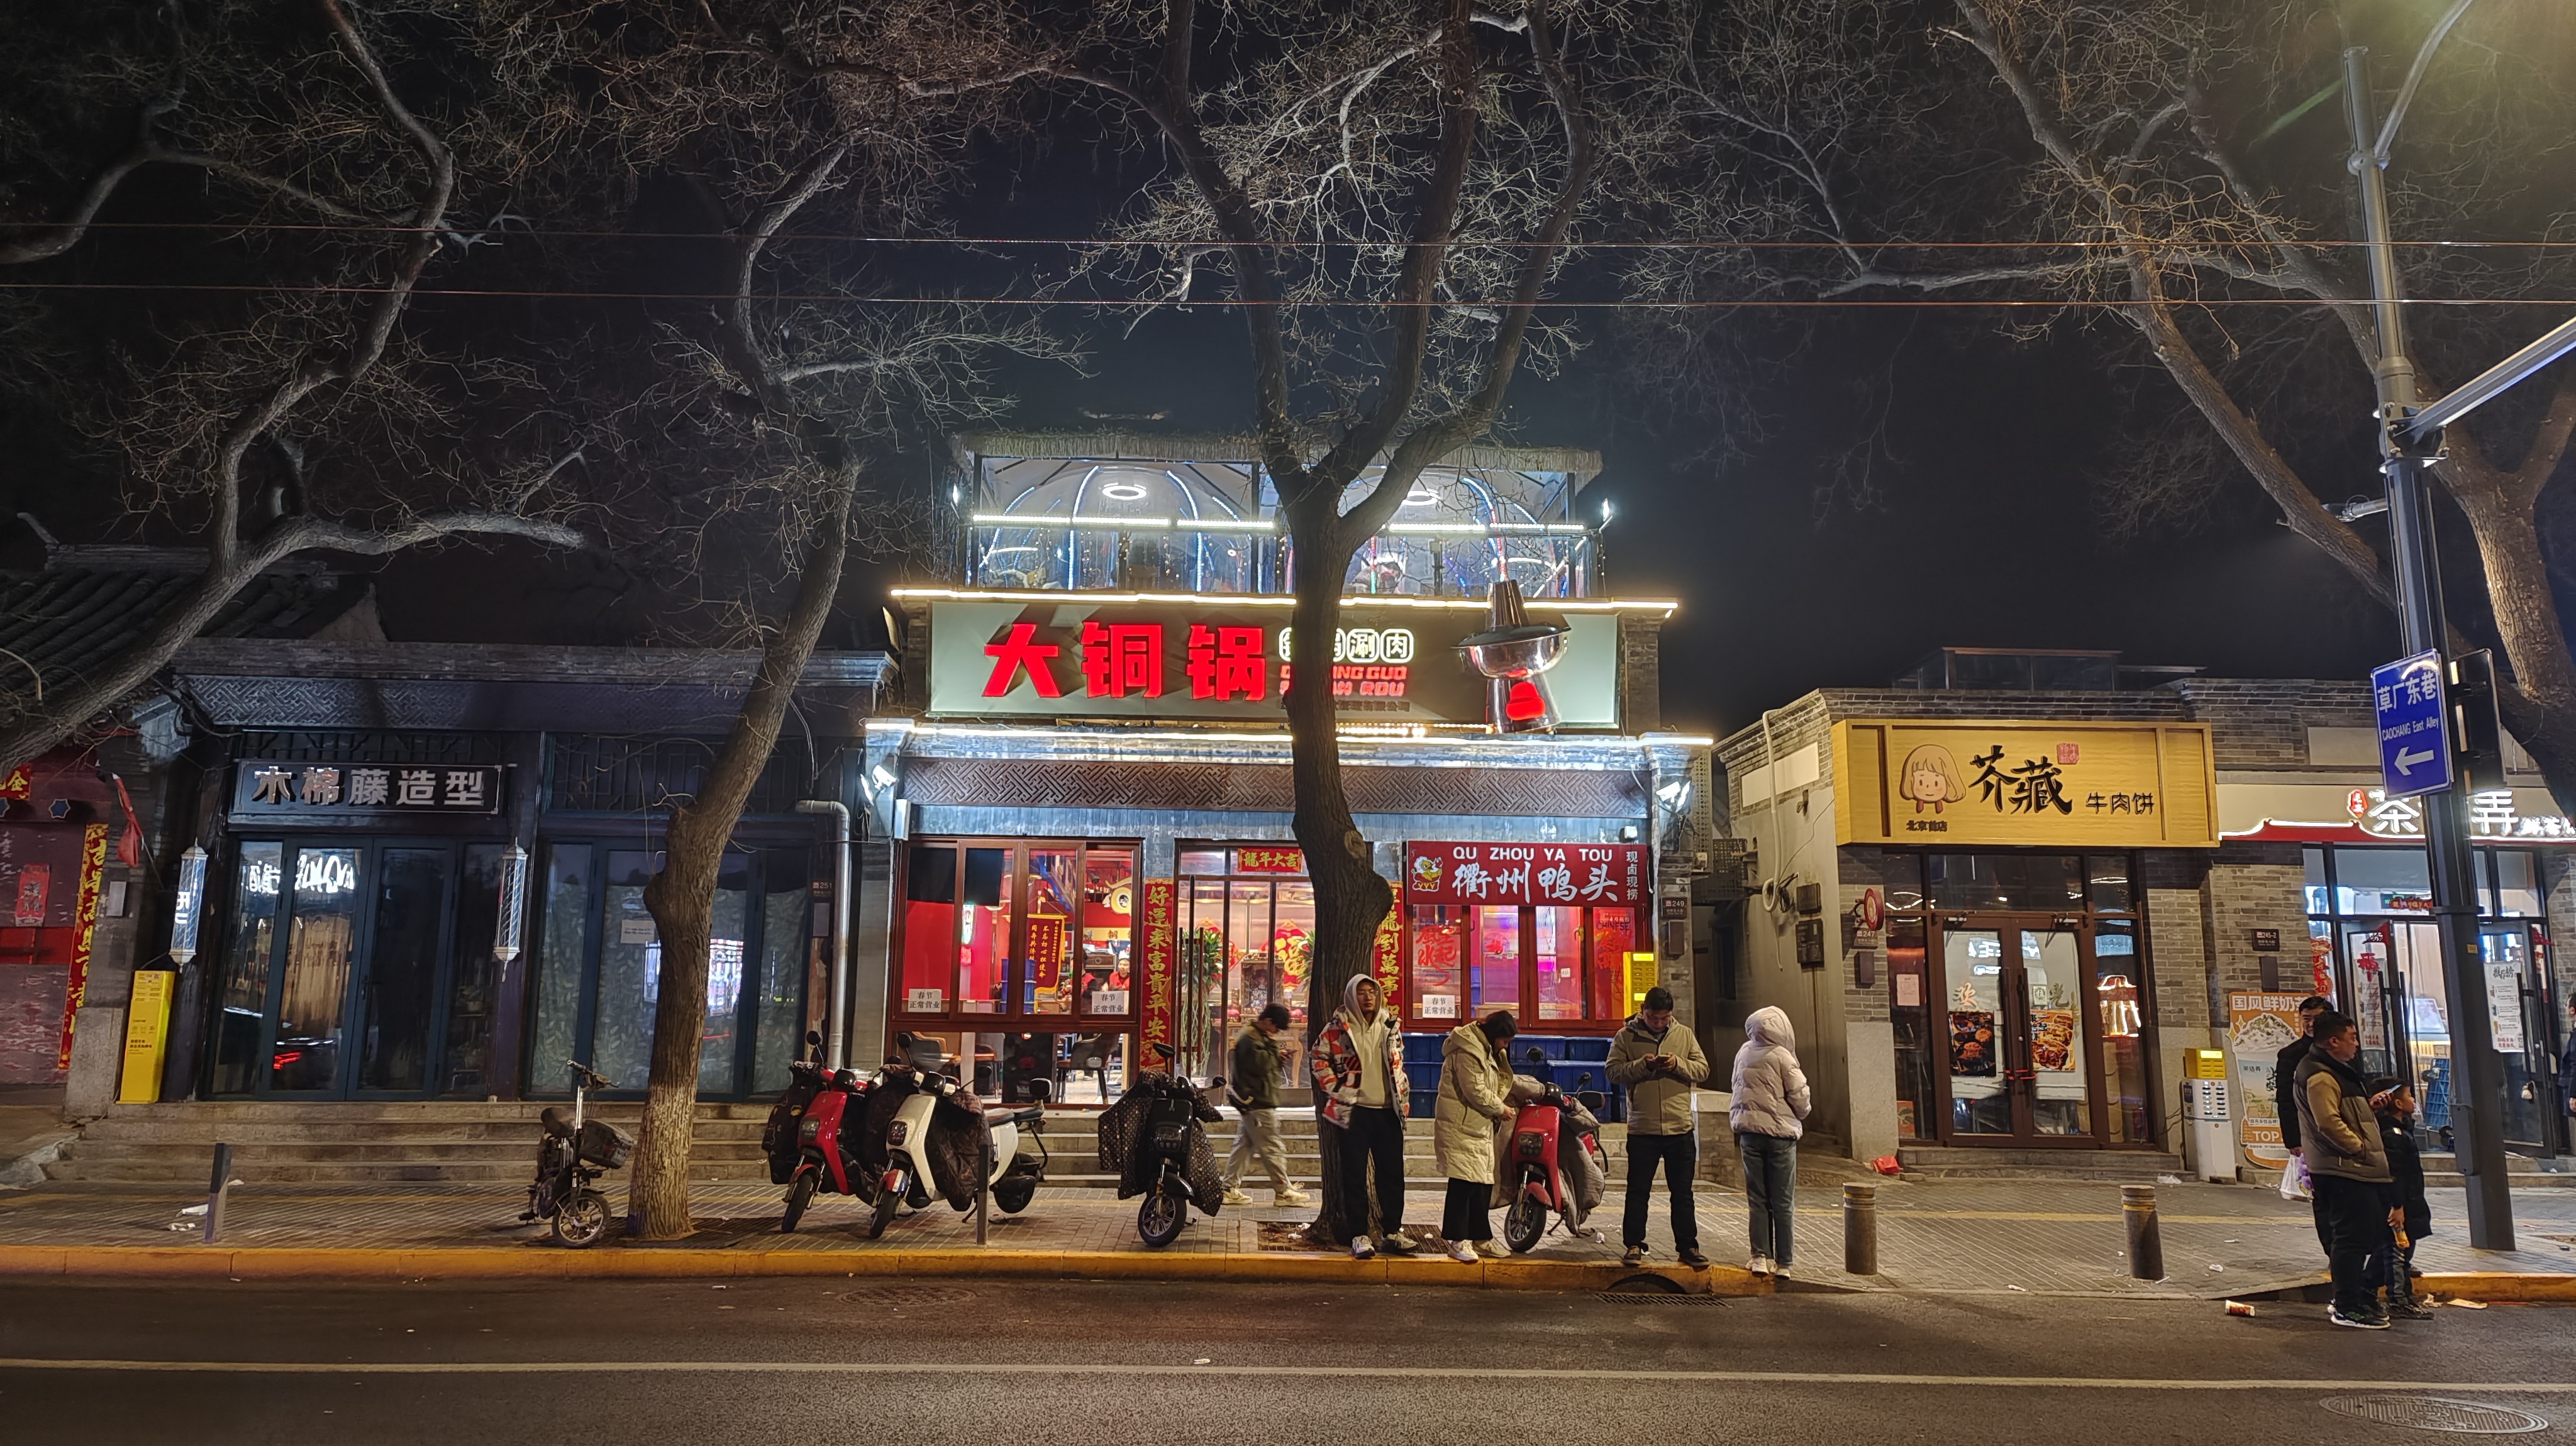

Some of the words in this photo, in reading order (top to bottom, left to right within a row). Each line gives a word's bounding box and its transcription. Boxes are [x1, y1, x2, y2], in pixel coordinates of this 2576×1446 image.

[982, 622, 1266, 701] 大铜锅
[1366, 666, 1407, 680] GUO
[1359, 681, 1405, 697] ROU
[2377, 671, 2436, 713] 草厂东巷
[2382, 722, 2411, 741] CAOCHANG
[2412, 720, 2424, 733] East
[2426, 716, 2439, 729] Alley
[252, 766, 485, 806] 木棉藤造型
[1968, 745, 2073, 815] 芥藏
[2085, 792, 2155, 815] 牛肉饼
[2368, 788, 2519, 835] 茶弄
[1906, 820, 1948, 832] 北京首店
[1243, 851, 1299, 868] 龍年大吉
[1453, 846, 1477, 860] QU
[1489, 847, 1535, 861] ZHOU
[1543, 848, 1566, 861] YA
[1579, 848, 1613, 862] TOU
[1452, 861, 1618, 903] 衢州鸭头
[1626, 851, 1639, 901] 现卤现捞
[909, 1000, 940, 1009] 正常营业
[1101, 993, 1116, 1002] 春节
[1431, 997, 1446, 1005] 春节
[1093, 1005, 1124, 1013] 正常营业
[1424, 1006, 1454, 1015] 正常营业
[2252, 1130, 2280, 1143] TOP
